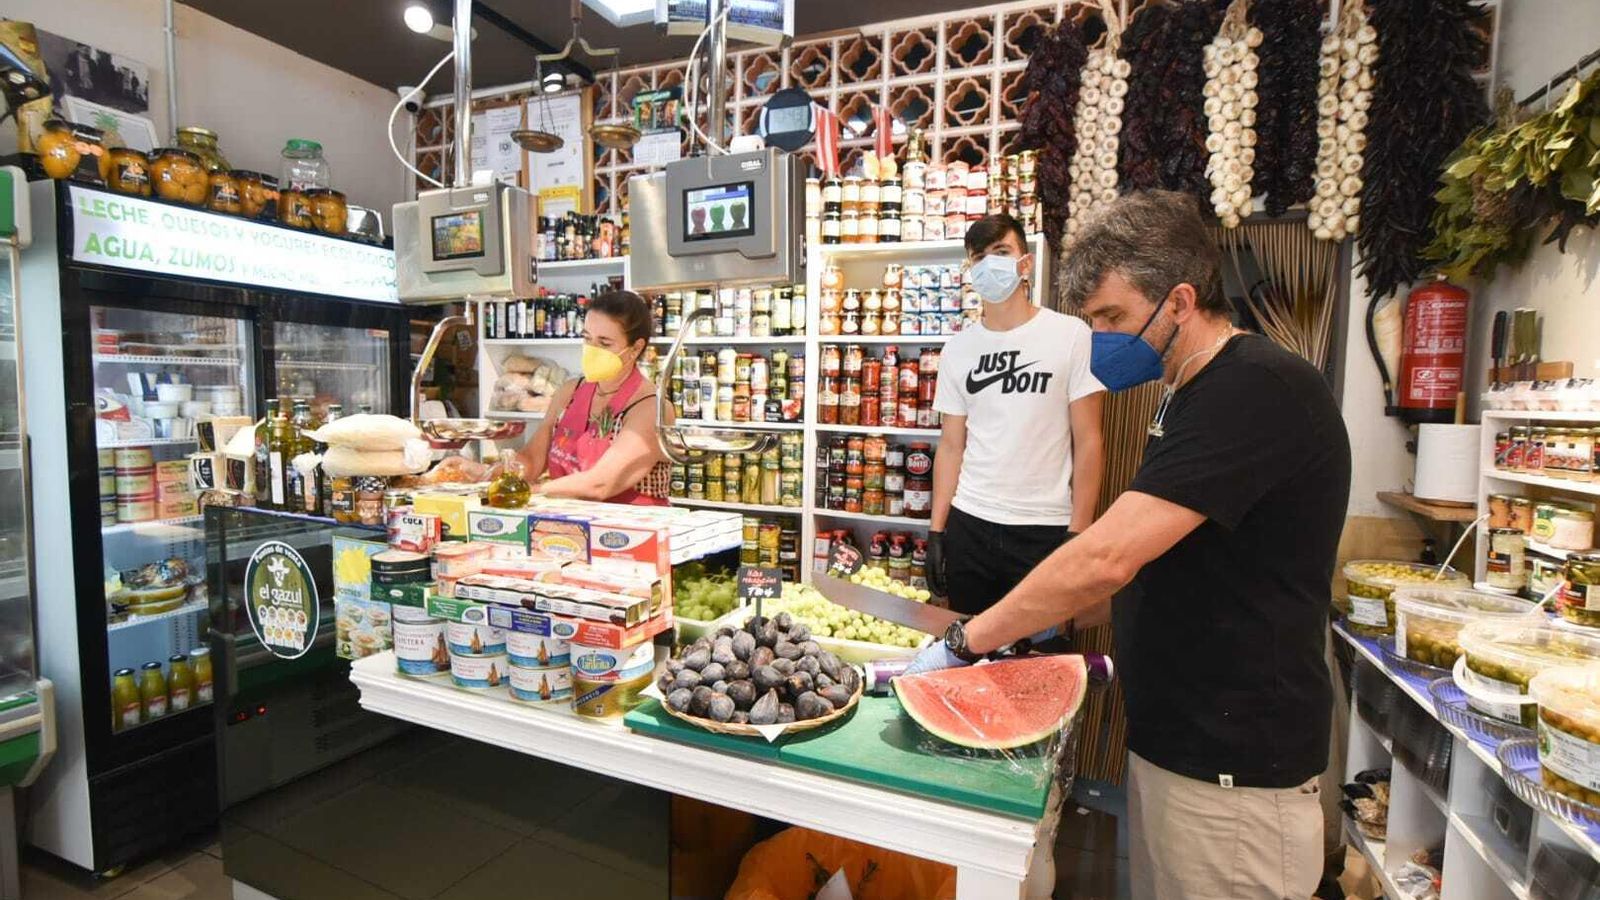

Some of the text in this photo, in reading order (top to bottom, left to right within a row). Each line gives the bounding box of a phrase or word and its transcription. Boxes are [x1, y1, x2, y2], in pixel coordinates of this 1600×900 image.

[84, 232, 160, 265] AGUA,
[168, 247, 235, 273] ZUMOS
[973, 350, 1021, 375] JUST
[1001, 372, 1053, 394] DO IT
[402, 516, 423, 526] CUCA
[259, 583, 303, 606] el gazul
